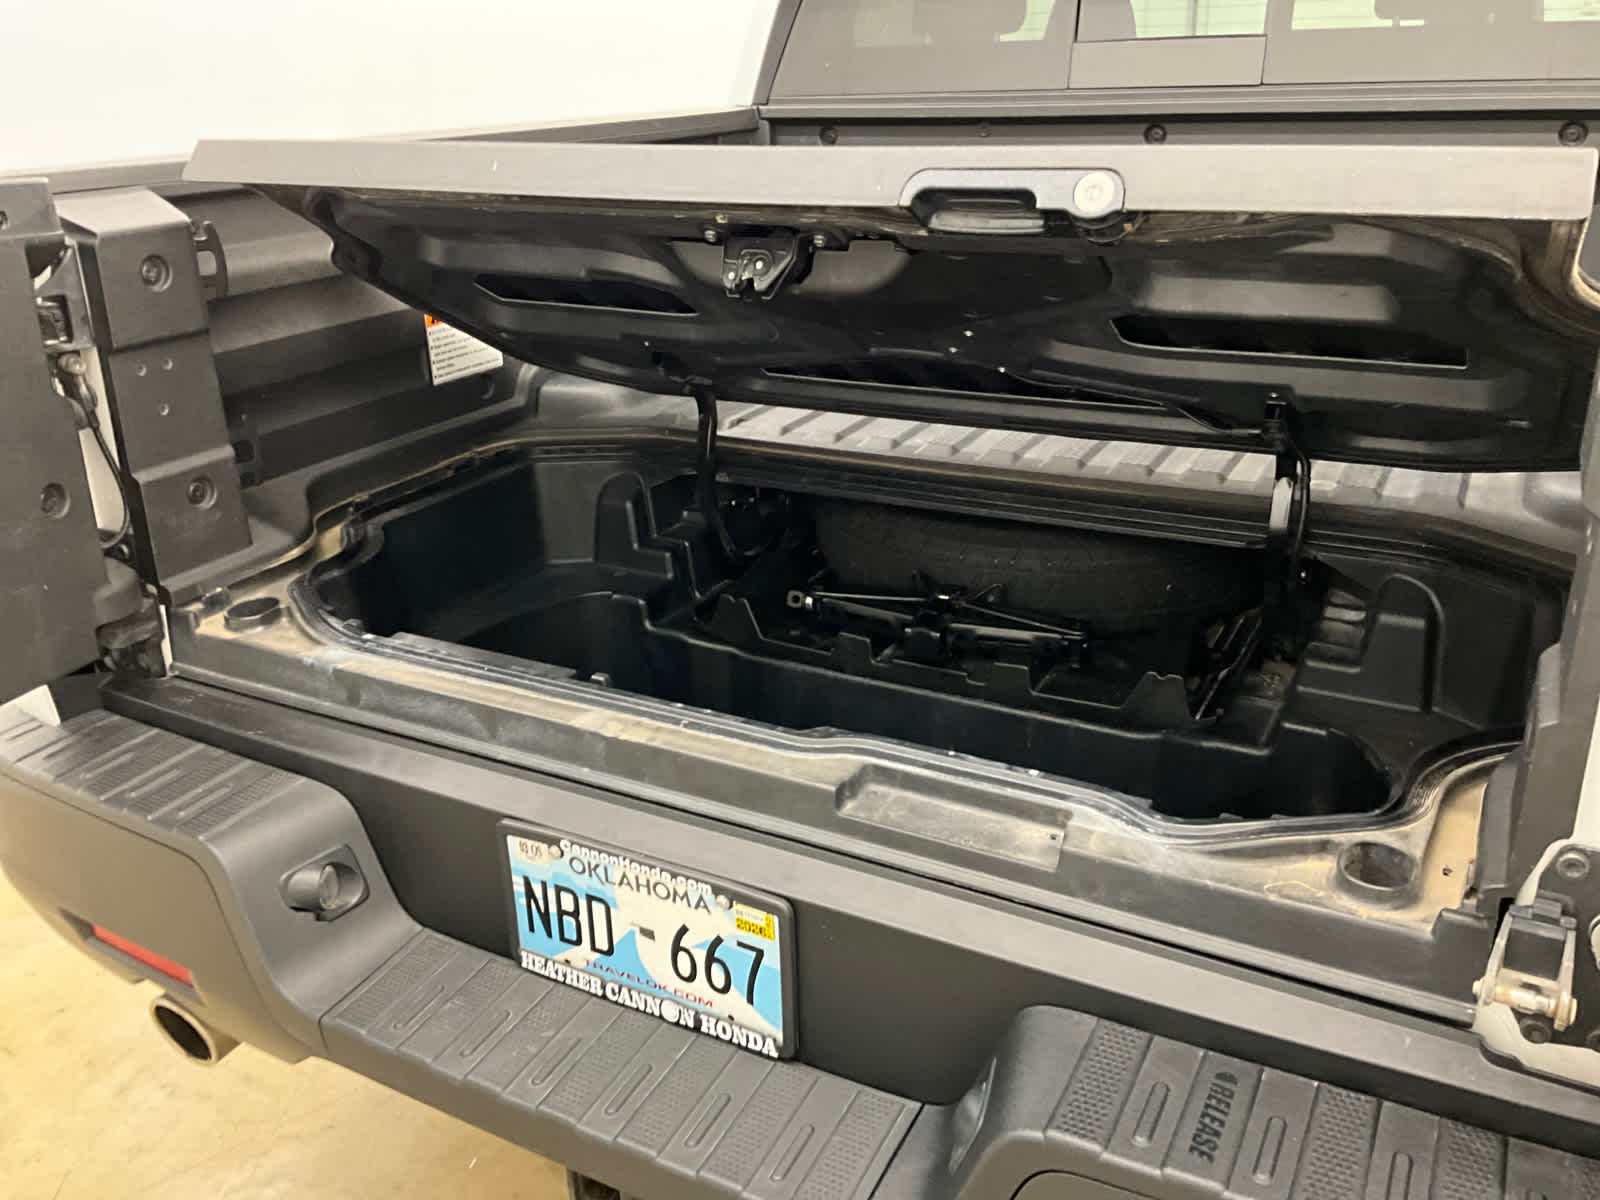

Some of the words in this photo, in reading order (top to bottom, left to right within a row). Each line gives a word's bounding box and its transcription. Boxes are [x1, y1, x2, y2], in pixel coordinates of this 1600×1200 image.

[569, 856, 712, 915] OKLAHOMA
[521, 951, 603, 997] HEATHER
[605, 981, 696, 1029] CANNON
[700, 1013, 779, 1058] HONDA
[1188, 1081, 1235, 1164] RELEASE
